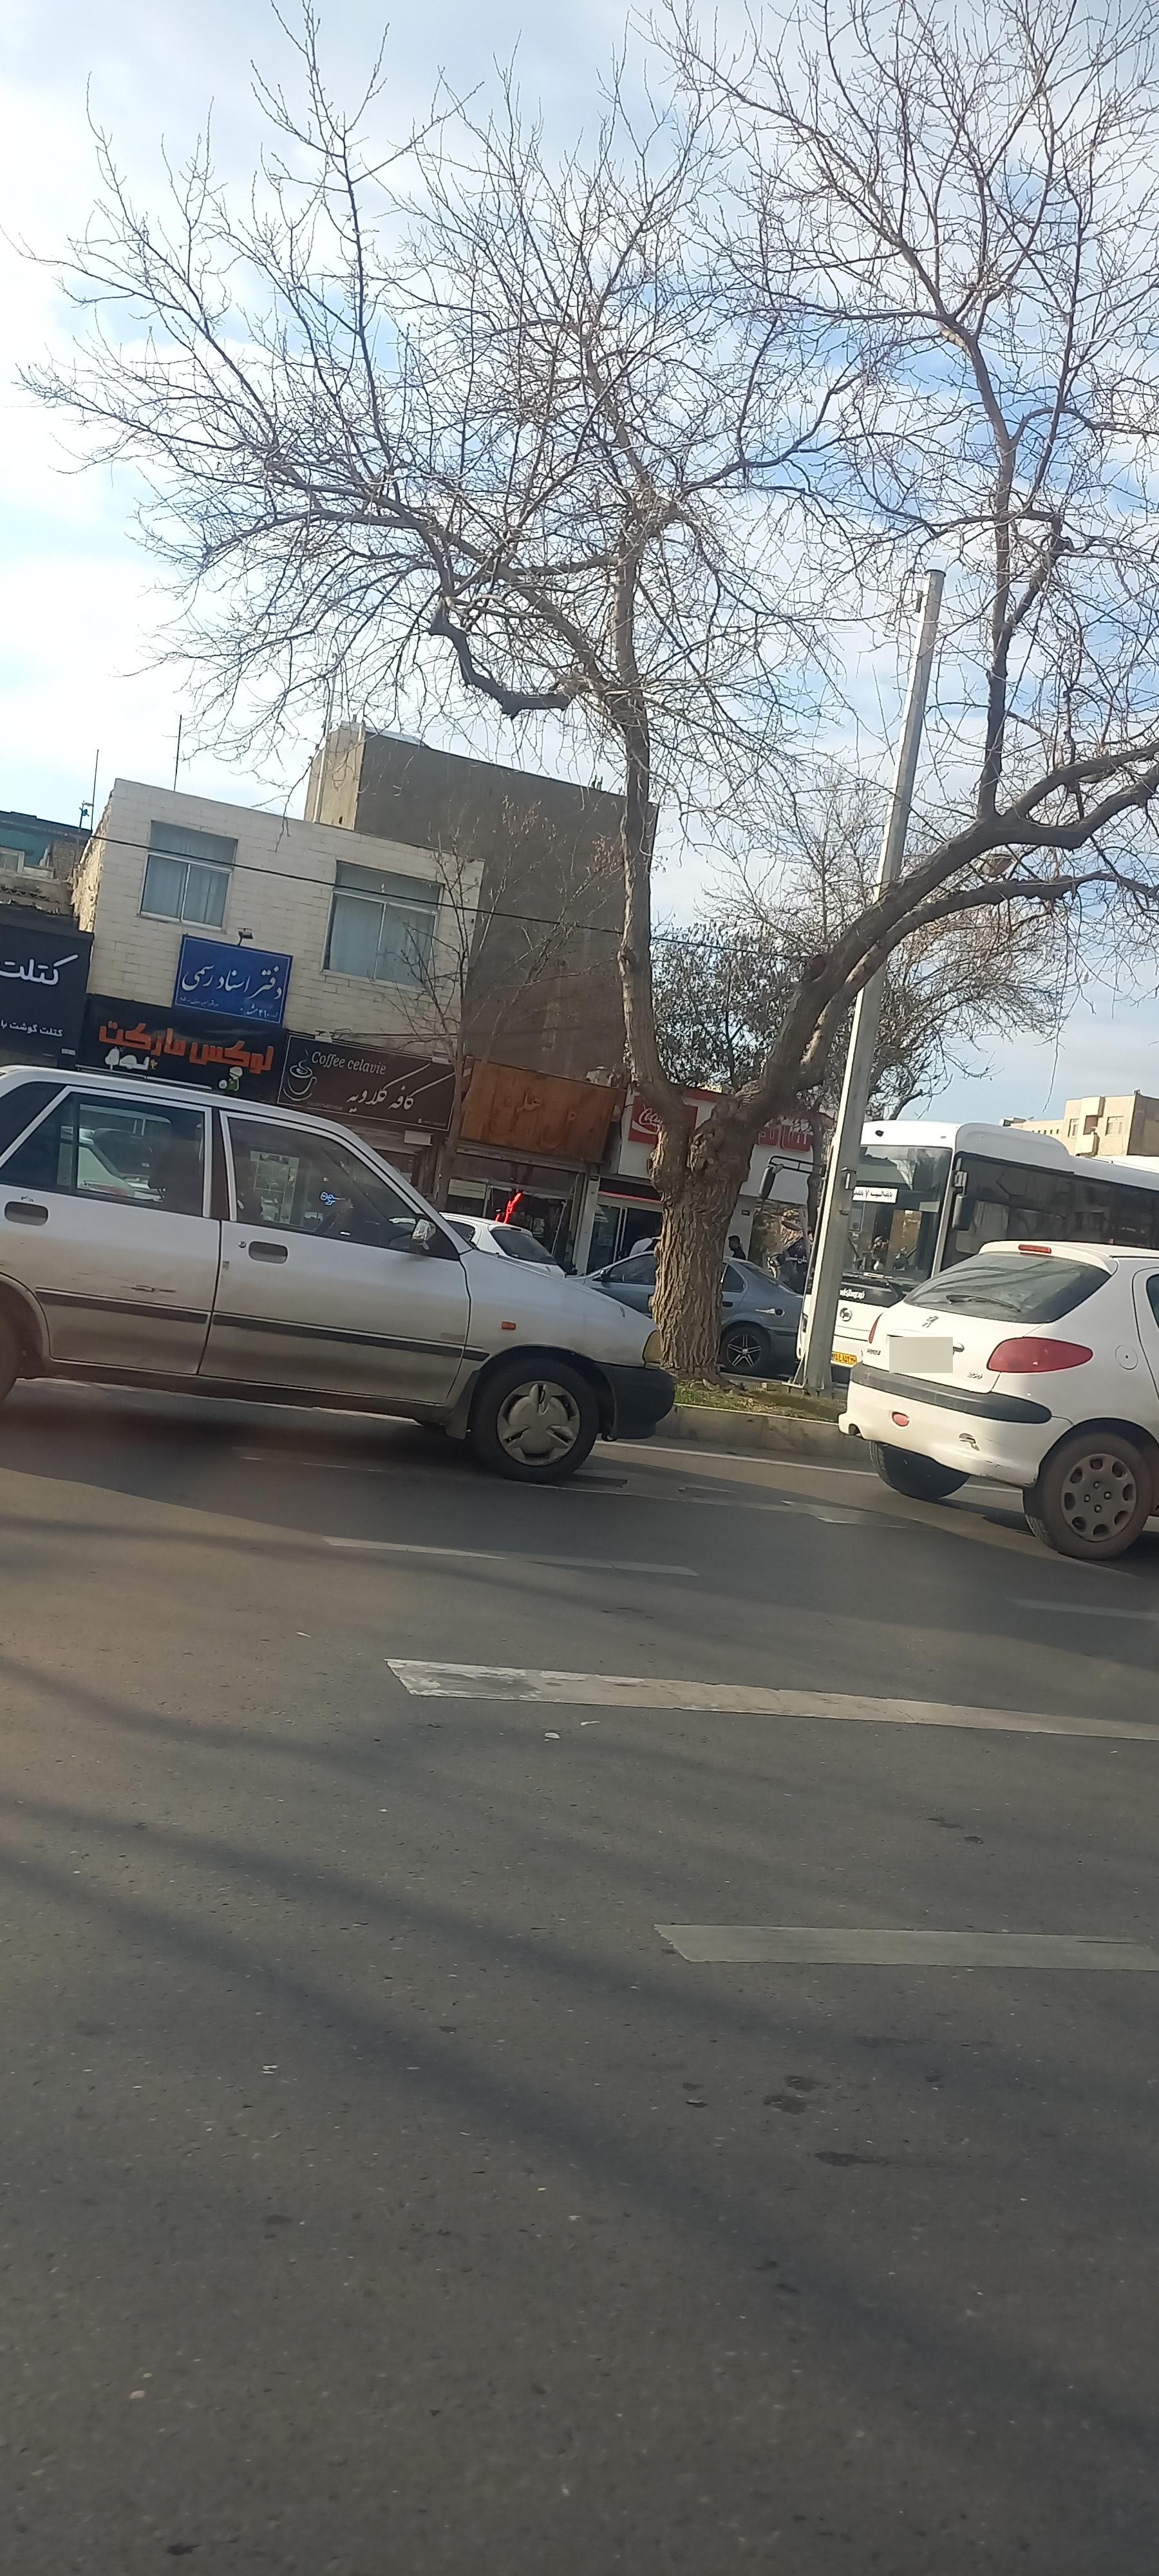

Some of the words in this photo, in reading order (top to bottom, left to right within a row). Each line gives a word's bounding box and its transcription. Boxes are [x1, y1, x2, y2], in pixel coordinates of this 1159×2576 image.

[182, 965, 215, 991] رسمی
[216, 970, 251, 993] اسناد
[247, 965, 283, 999] دفتر
[9, 1021, 38, 1034] گوشت
[39, 1027, 63, 1037] کتلت
[99, 1020, 187, 1057] مارکت
[189, 1041, 274, 1075] لوکس
[312, 1051, 345, 1068] Coffee
[347, 1058, 387, 1075] celavie
[388, 1072, 455, 1110] کافه
